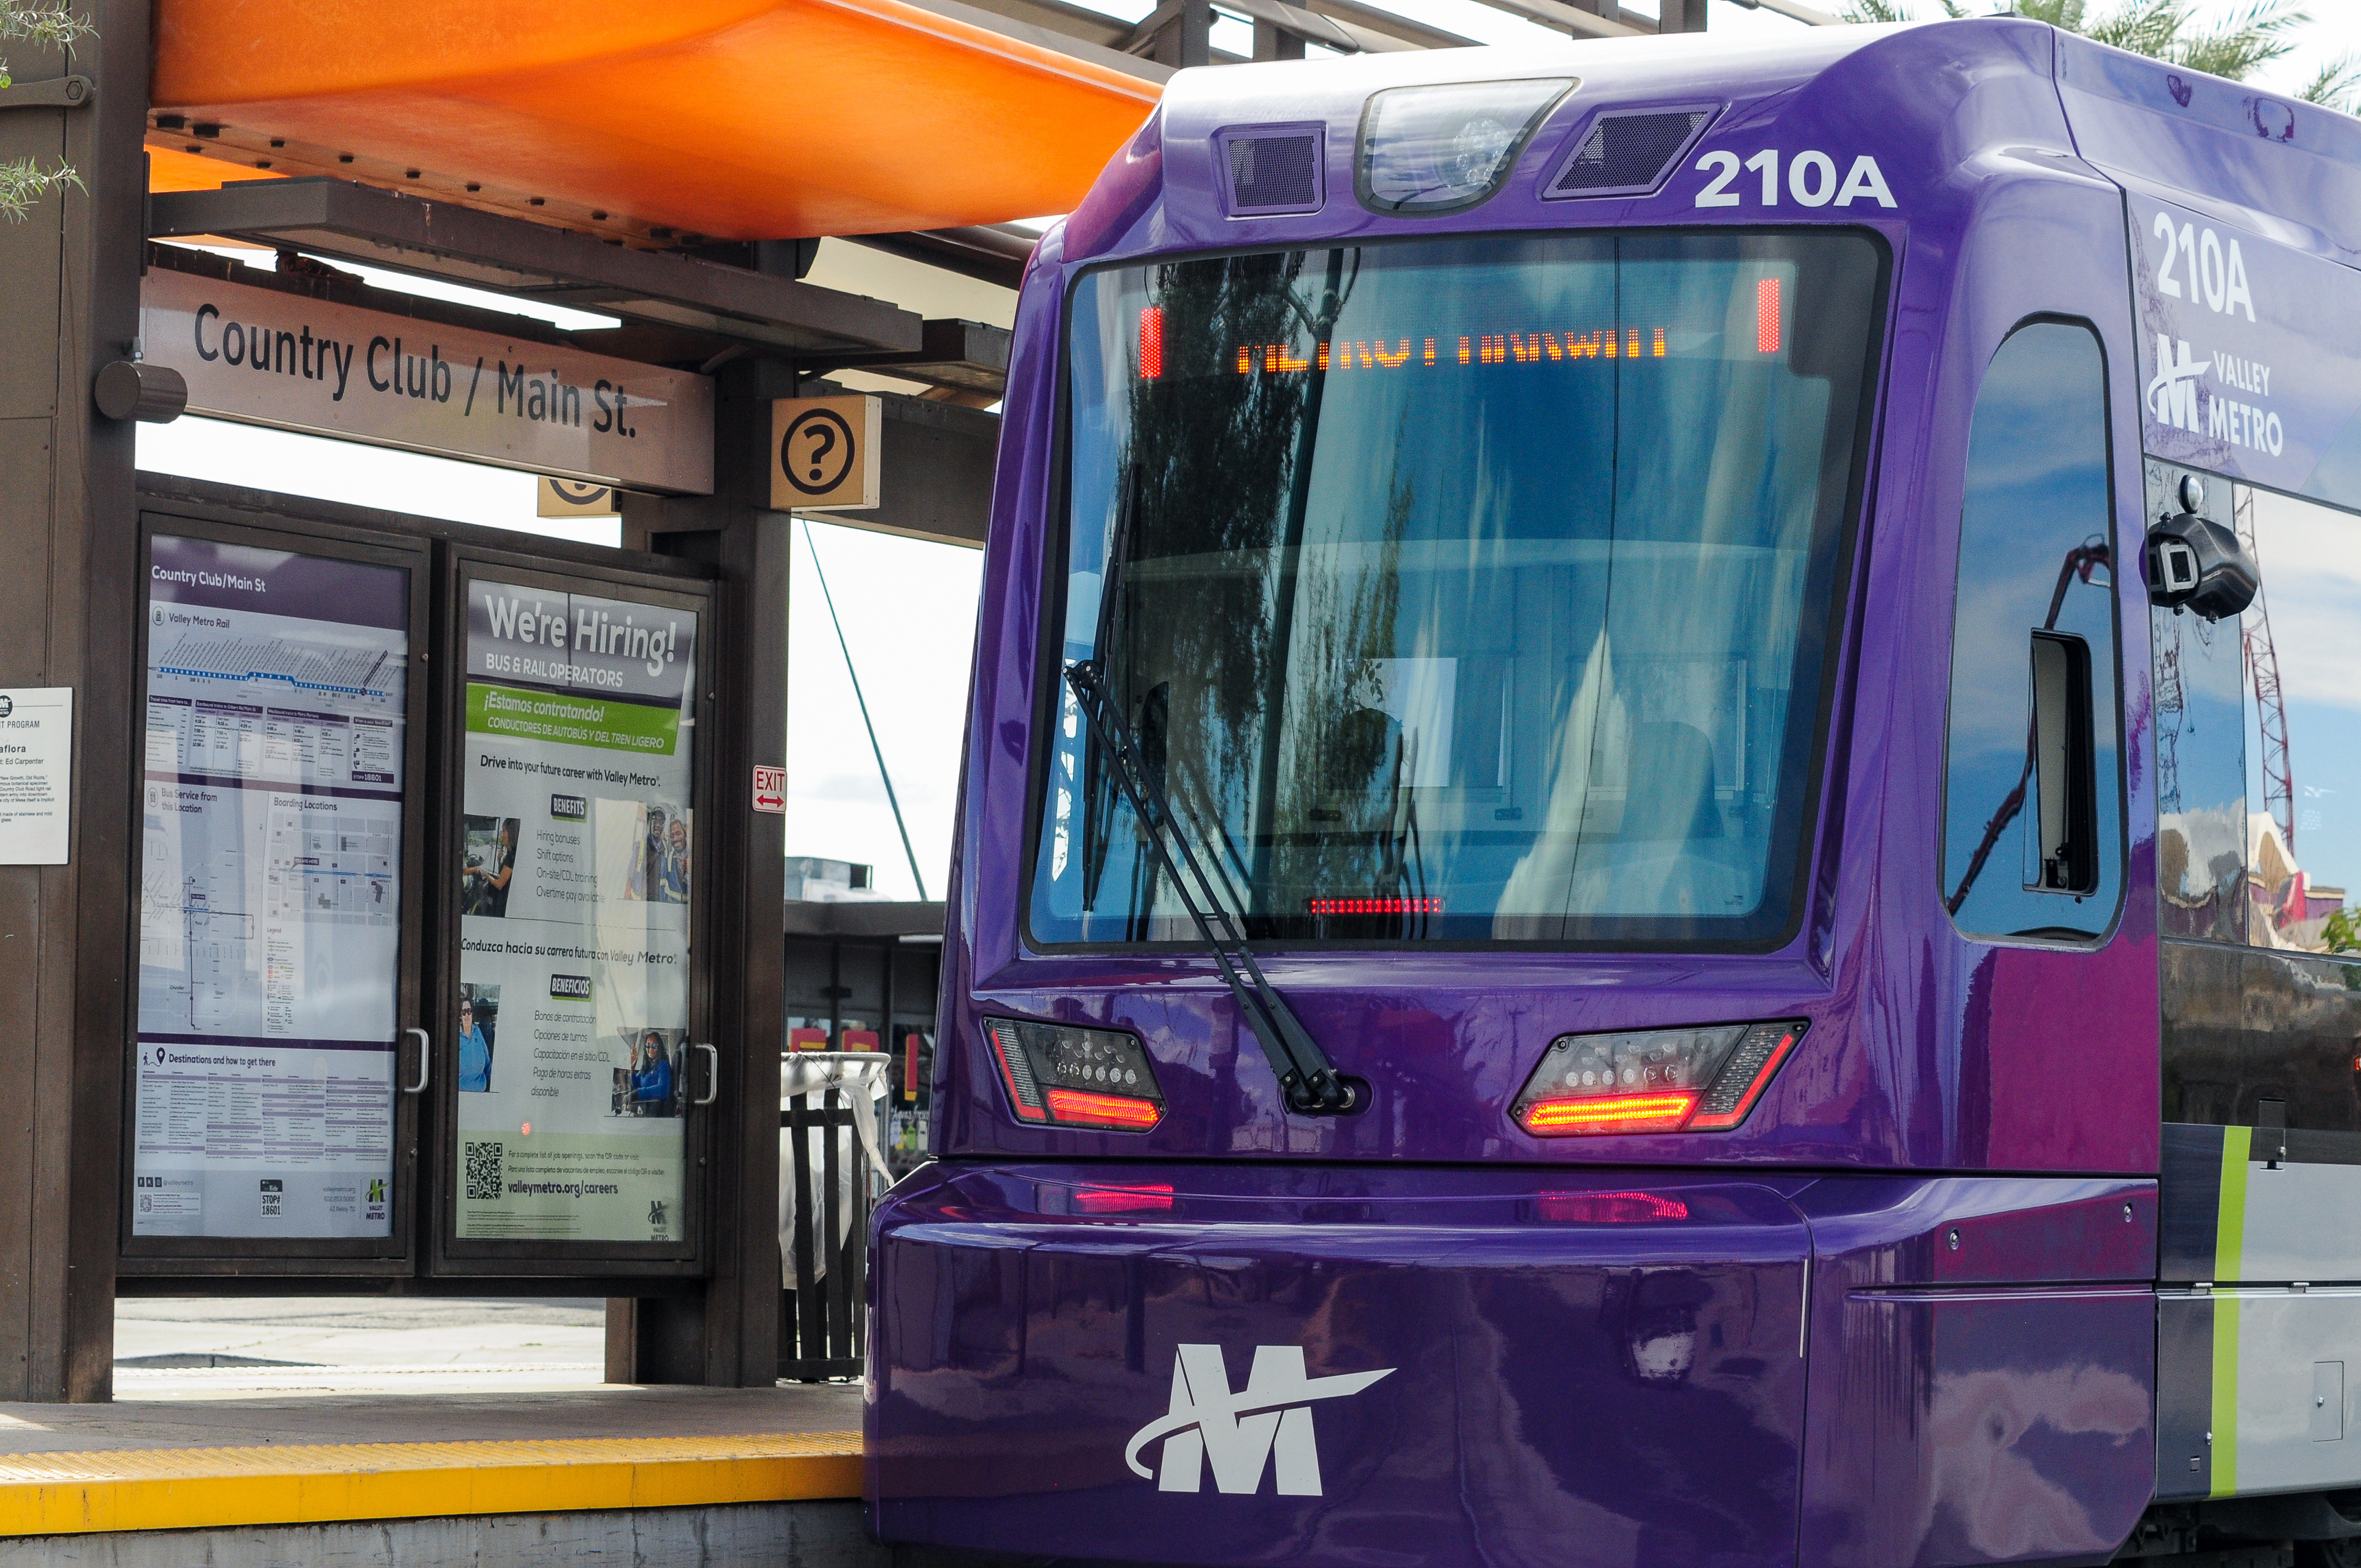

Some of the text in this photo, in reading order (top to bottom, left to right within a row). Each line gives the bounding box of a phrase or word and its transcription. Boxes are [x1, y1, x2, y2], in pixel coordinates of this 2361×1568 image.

[1695, 149, 1897, 208] 210A
[2154, 212, 2256, 323] 210A
[194, 303, 637, 438] Country Club / Main St.
[2213, 351, 2270, 396] VALLEY
[2209, 394, 2283, 457] METRO
[152, 565, 197, 586] Country
[255, 579, 266, 592] St
[169, 613, 230, 628] Valley Metro Rail
[485, 594, 677, 677] We're Hiring!
[486, 654, 623, 688] BUS & RAIL OPERATORS
[485, 691, 605, 722] ¡Estamos contratando!
[488, 717, 541, 734] CONDUCTORES
[542, 724, 552, 735] DE
[589, 730, 595, 741] Y
[595, 731, 610, 743] DEL
[612, 733, 631, 745] TREN
[632, 736, 664, 748] LIGERO
[480, 754, 506, 769] Drive
[508, 757, 523, 770] into
[524, 762, 540, 775] your
[540, 762, 561, 776] future
[562, 767, 585, 778] career
[586, 768, 603, 781] with
[605, 769, 628, 787] Valley
[757, 771, 785, 792] EXIT
[162, 788, 217, 802] Bus Service from
[274, 797, 338, 811] Boarding Locations
[162, 802, 202, 813] this Location
[553, 798, 585, 815] BENEFITS
[536, 829, 580, 846] Hiring bonuses
[536, 848, 574, 864] Shift options
[536, 867, 599, 888] On-site/CDL training
[536, 885, 565, 900] Overtime
[566, 890, 576, 903] pay
[461, 938, 503, 952] Conduzca
[505, 940, 532, 954] hacia
[535, 945, 545, 955] su
[547, 946, 574, 957] carrera
[575, 946, 596, 959] futura
[597, 951, 608, 961] con
[610, 949, 634, 966] Valley
[552, 977, 590, 995] BENEFICIOS
[534, 1010, 553, 1021] Bonos
[554, 1012, 562, 1022] de
[534, 1028, 587, 1042] Opciones de turnos
[169, 1053, 276, 1069] Destinations and how to get there
[533, 1066, 591, 1080] Pago de horas extras
[531, 1086, 559, 1098] disponible
[508, 1179, 618, 1198] valleymetro.org/careers
[262, 1195, 280, 1204] STOP#
[262, 1205, 280, 1215] 18601
